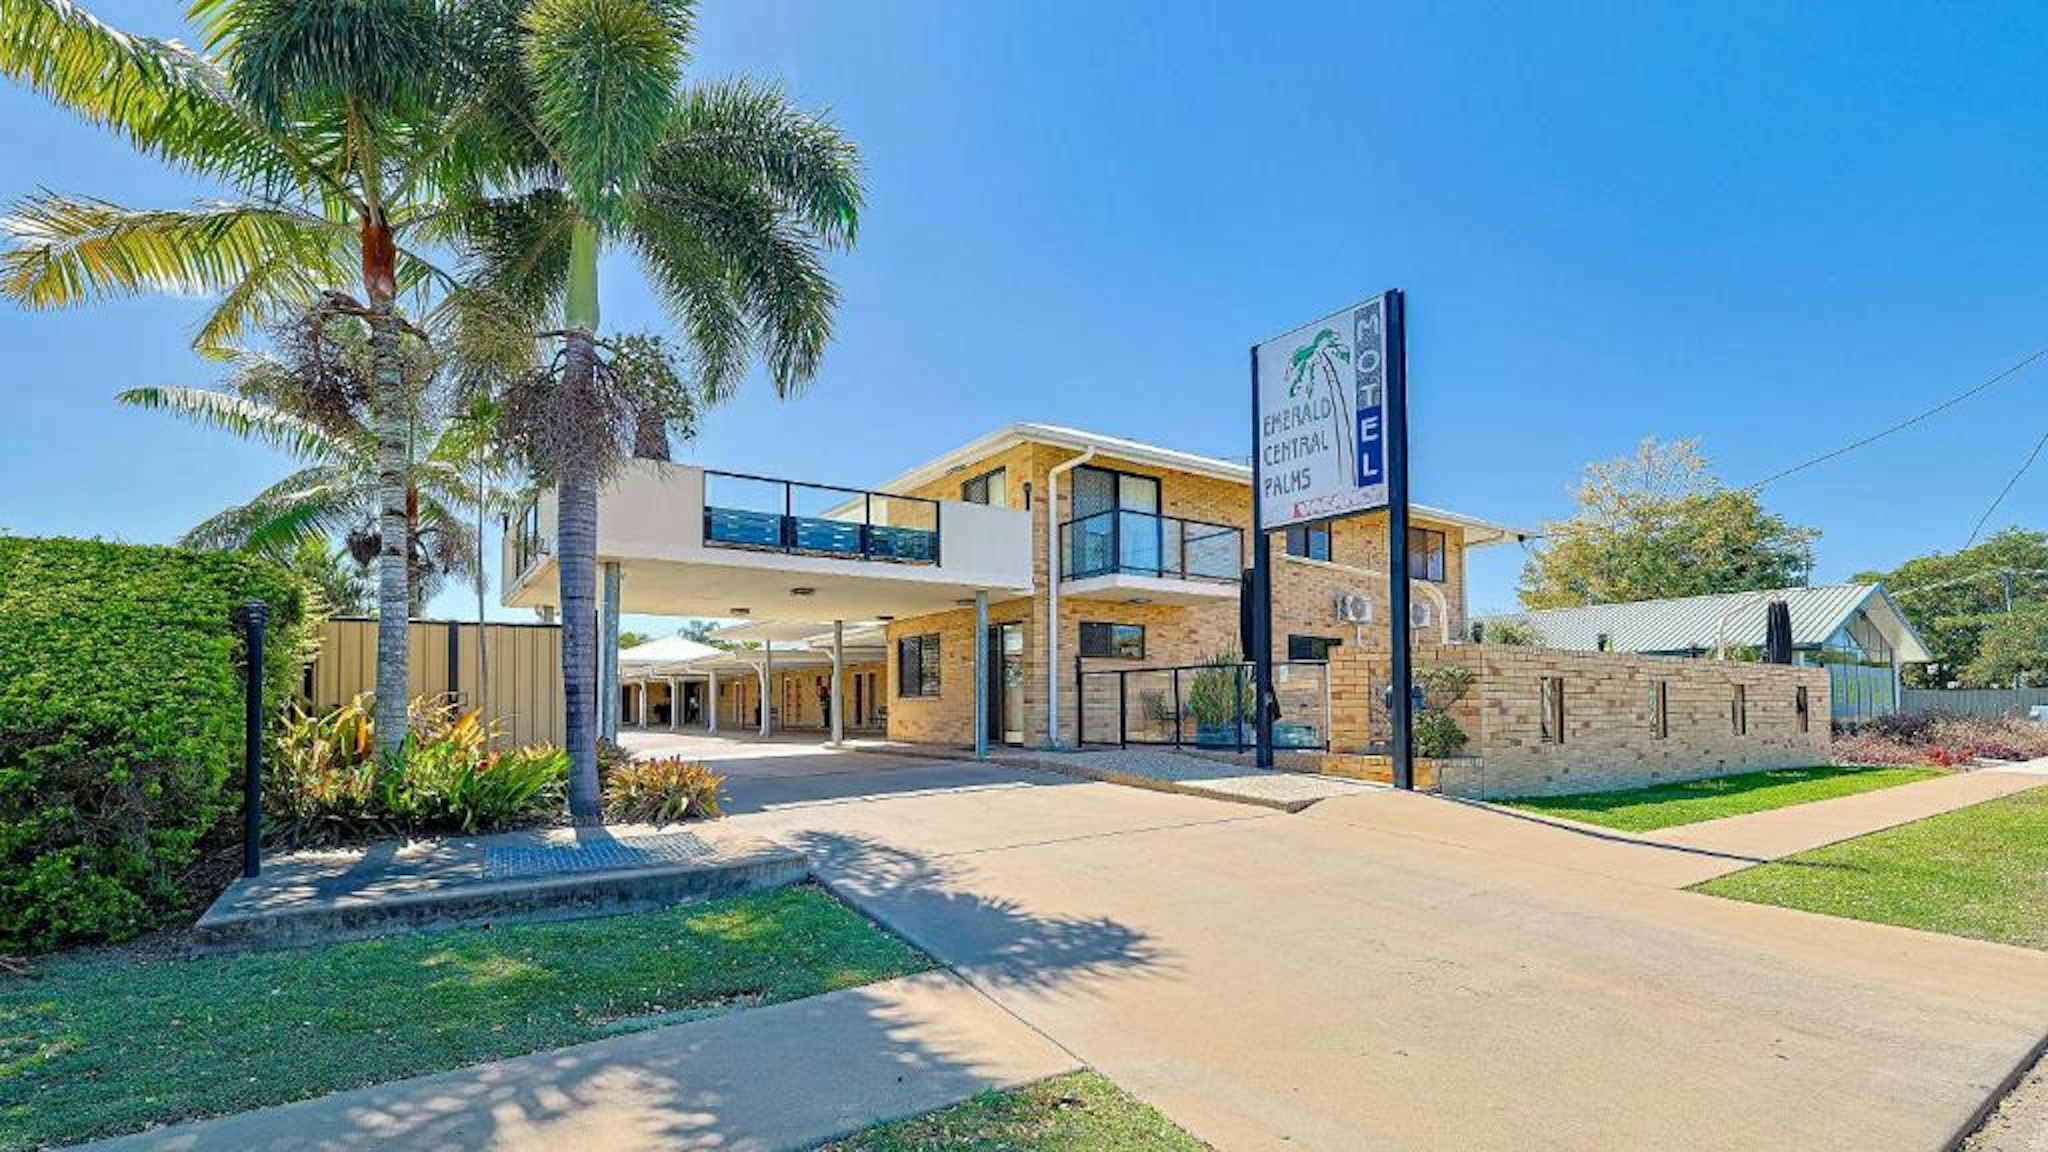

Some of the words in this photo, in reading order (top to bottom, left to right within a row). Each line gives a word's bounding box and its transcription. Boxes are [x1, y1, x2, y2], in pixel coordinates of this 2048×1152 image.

[1356, 313, 1381, 478] MOTEL
[1264, 398, 1331, 436] EMERALD
[1264, 430, 1328, 466] CENTRAL
[1264, 468, 1311, 497] PALMS
